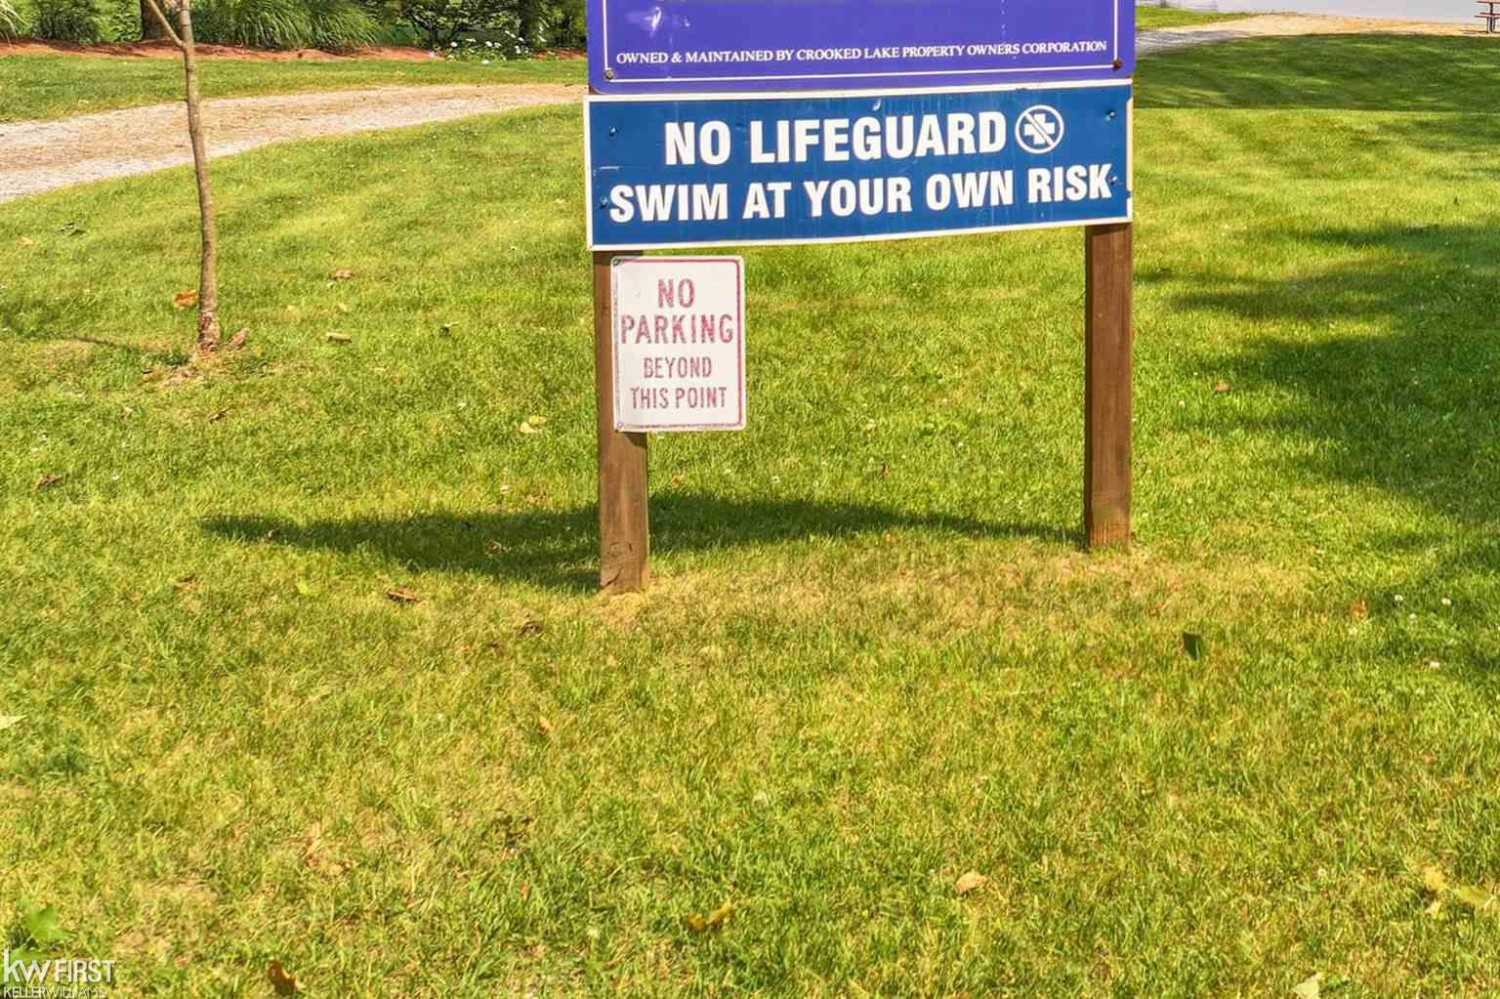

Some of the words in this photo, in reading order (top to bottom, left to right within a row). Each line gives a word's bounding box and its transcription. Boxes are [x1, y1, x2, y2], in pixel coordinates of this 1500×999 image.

[616, 52, 668, 64] OWNED
[671, 53, 682, 64] &
[685, 50, 774, 63] MAINTAINED
[776, 49, 793, 61] BY
[796, 48, 862, 61] CROOKED
[864, 47, 900, 59] LAKE
[902, 45, 964, 58] PROPERTY
[967, 43, 1020, 56] OWNERS
[1022, 40, 1107, 55] CORPORATION
[664, 121, 730, 166] NO
[749, 111, 1007, 165] LIFEGUARD
[609, 184, 728, 223] SWIM
[743, 182, 793, 218] AT
[803, 177, 912, 217] YOUR
[925, 170, 1014, 210] OWN
[1027, 163, 1112, 203] RISK
[657, 278, 695, 309] NO
[620, 313, 734, 345] PARKING
[643, 356, 712, 379] BEYOND
[630, 386, 669, 409] THIS
[675, 386, 727, 408] POINT
